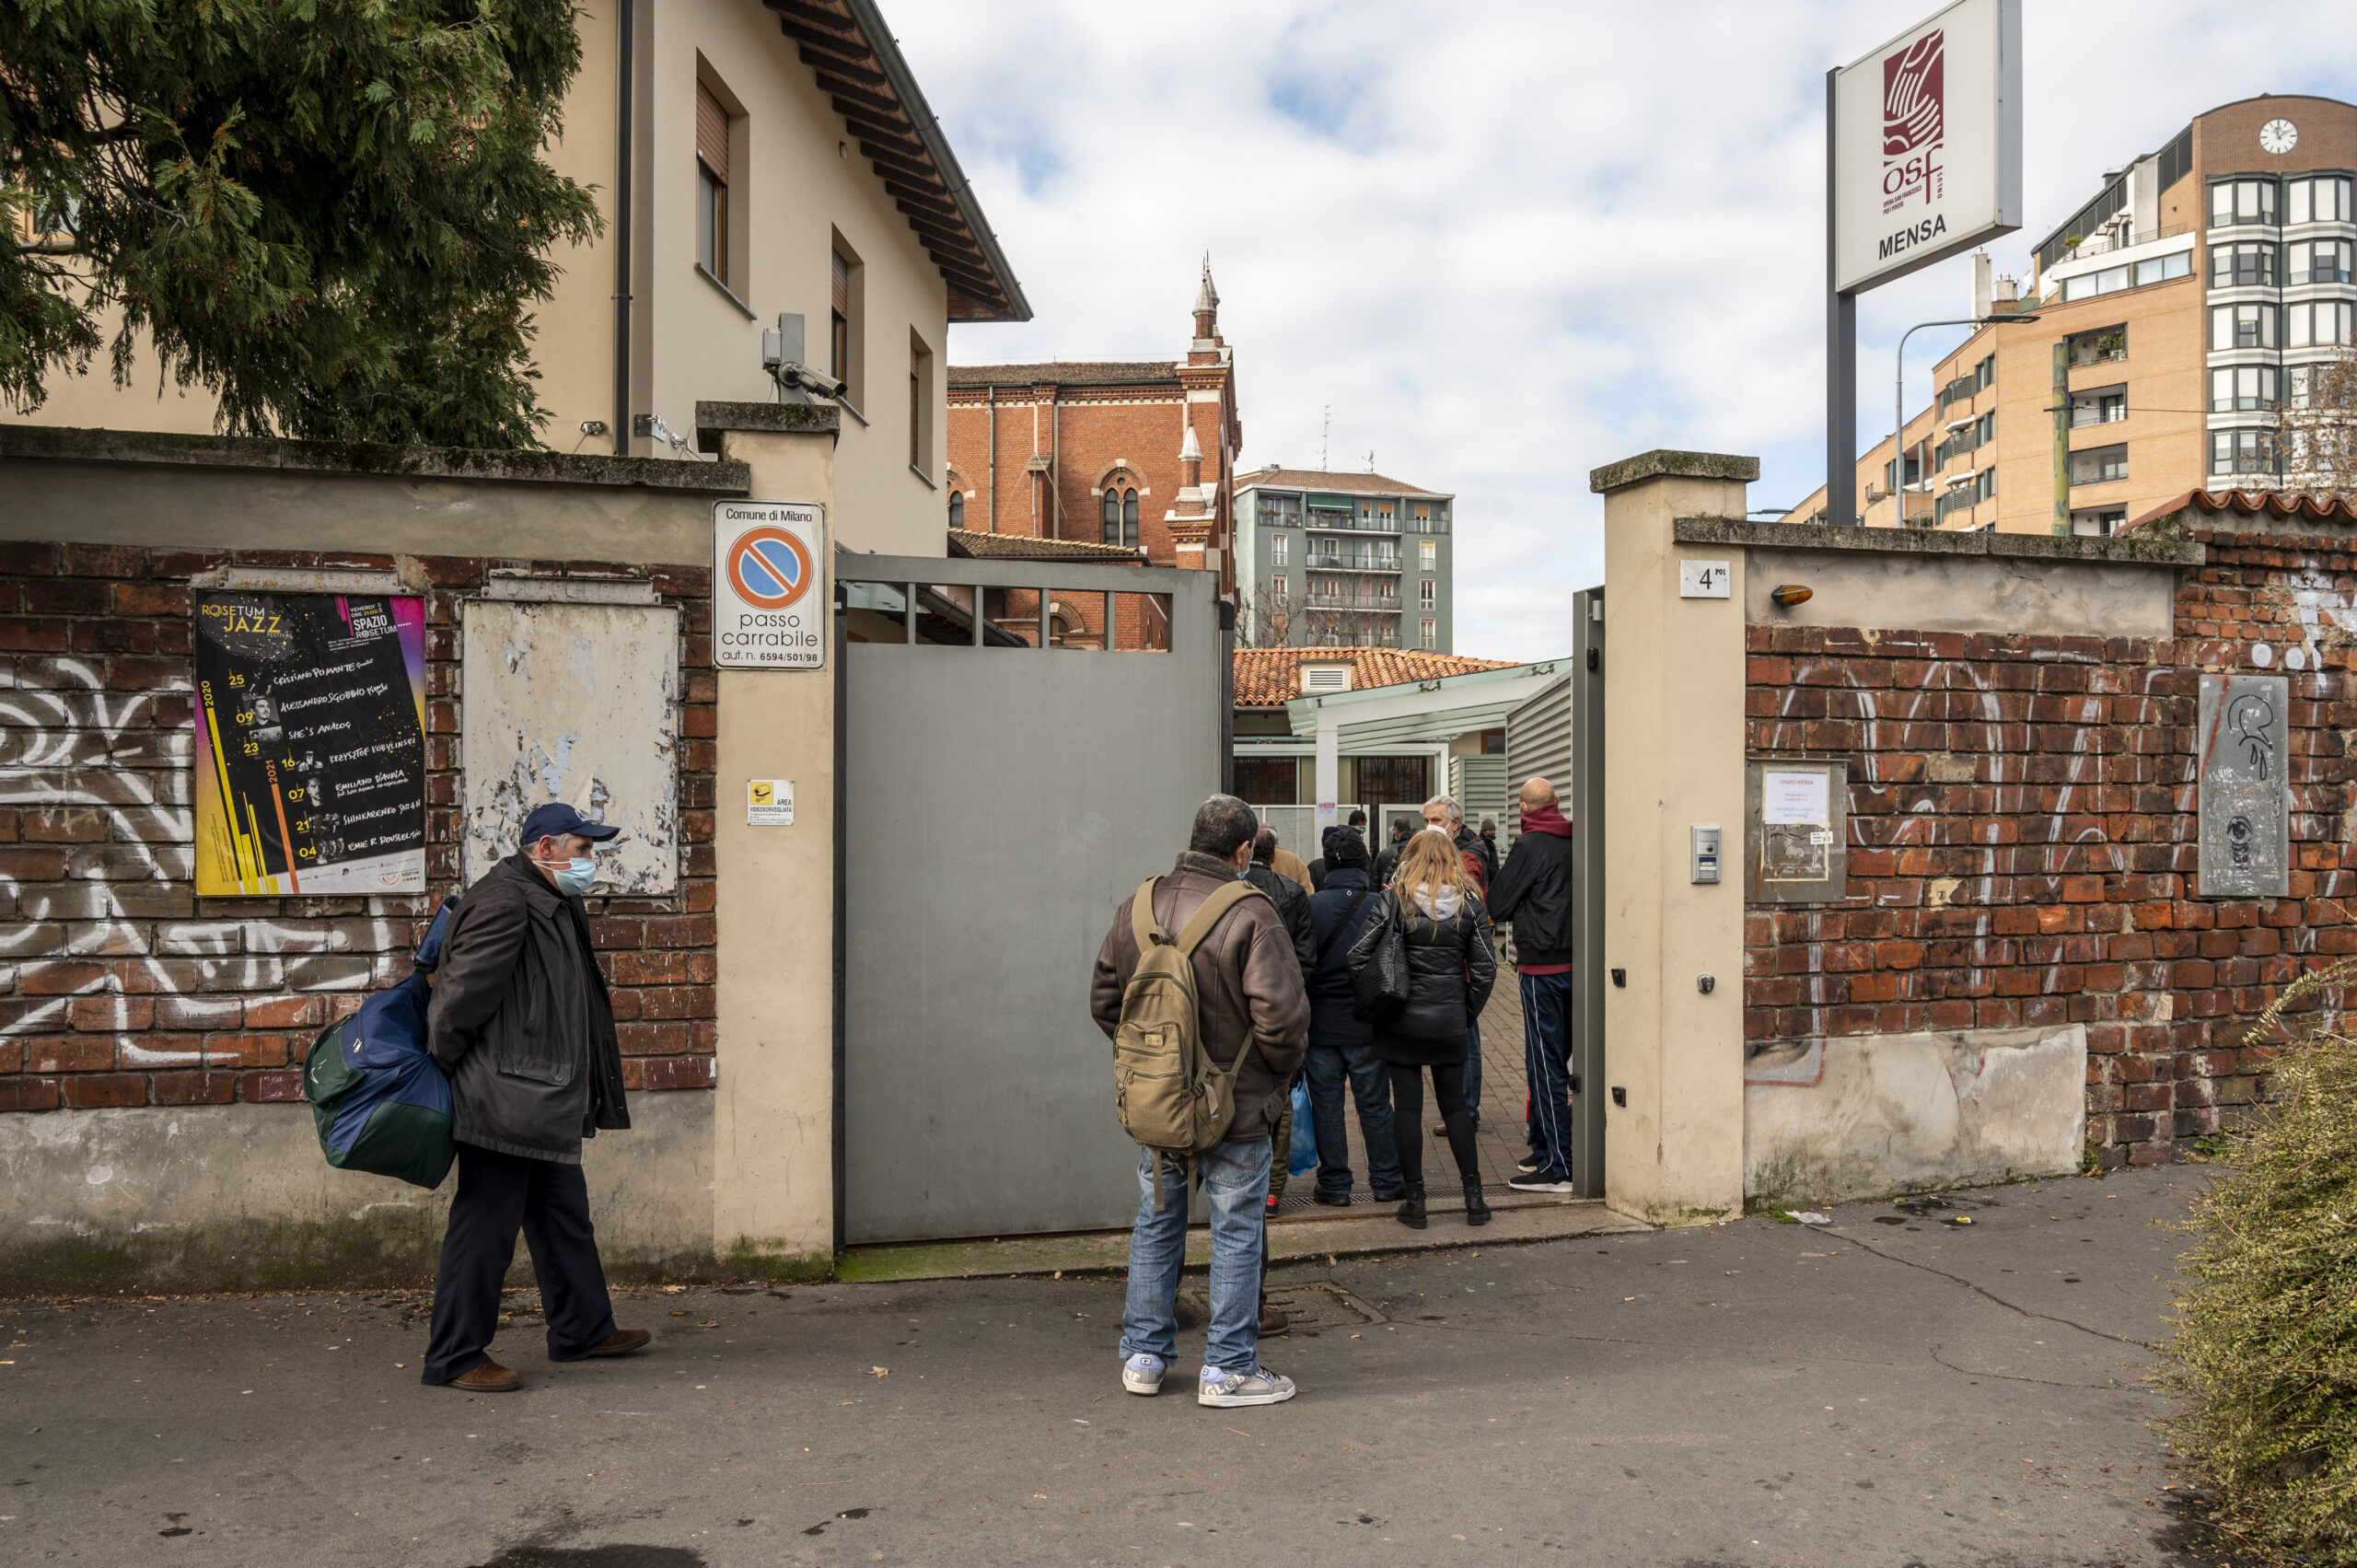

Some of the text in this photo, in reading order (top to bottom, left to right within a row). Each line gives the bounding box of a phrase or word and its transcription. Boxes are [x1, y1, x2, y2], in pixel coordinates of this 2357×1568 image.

[1883, 184, 1922, 208] OPERA SAN FRANCESCO
[1892, 201, 1904, 212] POVERI
[1879, 214, 1946, 261] MENSA
[726, 508, 812, 522] Comune di Milano
[1700, 568, 1713, 590] 4
[202, 604, 265, 617] ROSETUM
[224, 615, 281, 633] JAZZ
[354, 614, 388, 631] SPAZIO
[740, 614, 800, 630] passo
[355, 625, 398, 639] ROSETUM
[722, 631, 818, 647] carrabile
[722, 650, 818, 662] aut. n. 6594/501/98
[228, 674, 245, 686] 25
[201, 680, 215, 707] 2020
[280, 696, 328, 713] ALESSANDRO
[328, 688, 366, 703] SGOBBIO
[236, 712, 253, 724] 09
[288, 721, 352, 740] SHE'S ANALOG
[244, 742, 259, 754] 23
[329, 747, 370, 763] KRZYSZTOF
[265, 759, 278, 783] 2021
[282, 758, 296, 769] 16
[335, 777, 372, 792] EMILIANO
[288, 788, 305, 800] 07
[343, 807, 397, 825] SHINKARENKO
[296, 819, 310, 831] 21
[299, 846, 317, 858] 04
